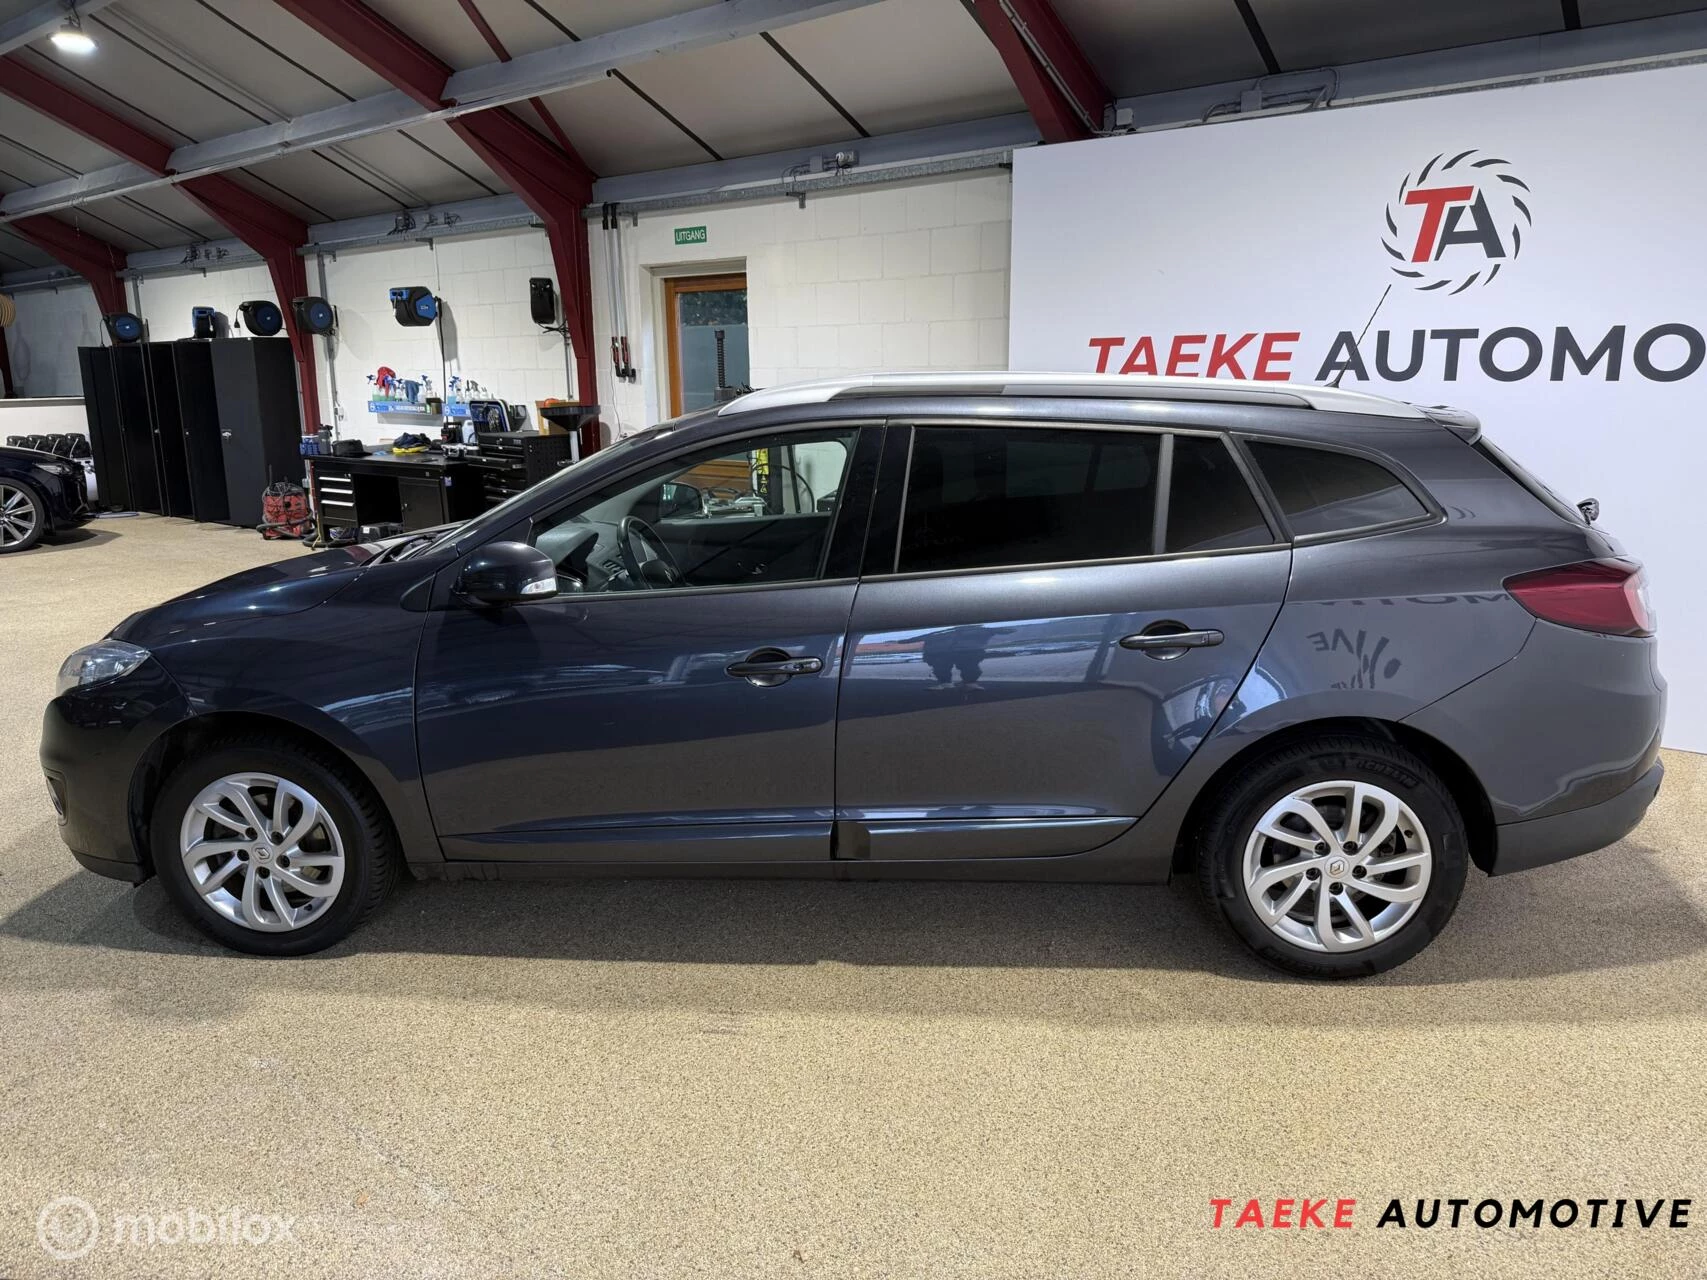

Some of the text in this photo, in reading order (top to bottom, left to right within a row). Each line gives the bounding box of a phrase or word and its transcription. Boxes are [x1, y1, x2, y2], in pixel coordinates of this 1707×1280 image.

[675, 229, 706, 242] UITGANG
[1405, 186, 1507, 263] TA
[1088, 331, 1301, 382] TAEKE
